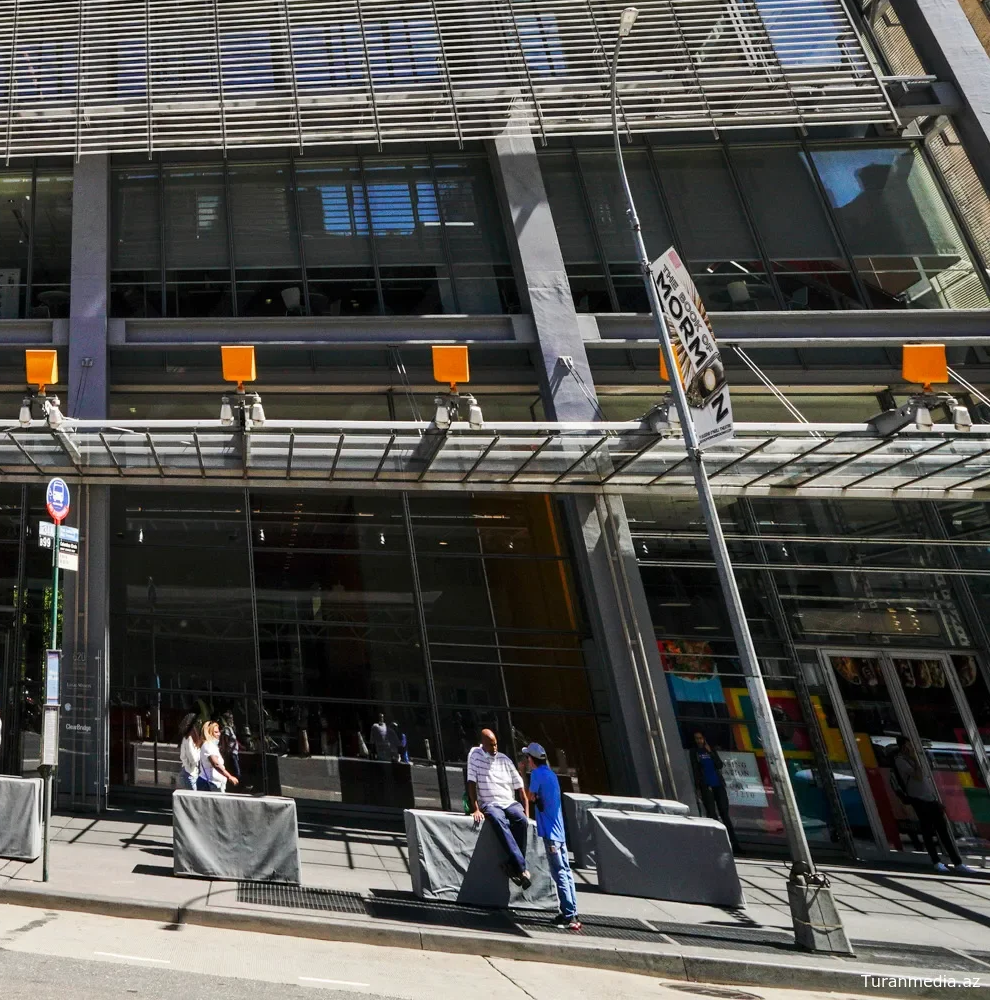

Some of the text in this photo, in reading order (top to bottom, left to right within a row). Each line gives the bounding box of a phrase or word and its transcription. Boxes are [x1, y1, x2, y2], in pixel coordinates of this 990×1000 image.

[662, 264, 714, 352] THE BOOK OF
[65, 723, 91, 732] ClearBridge
